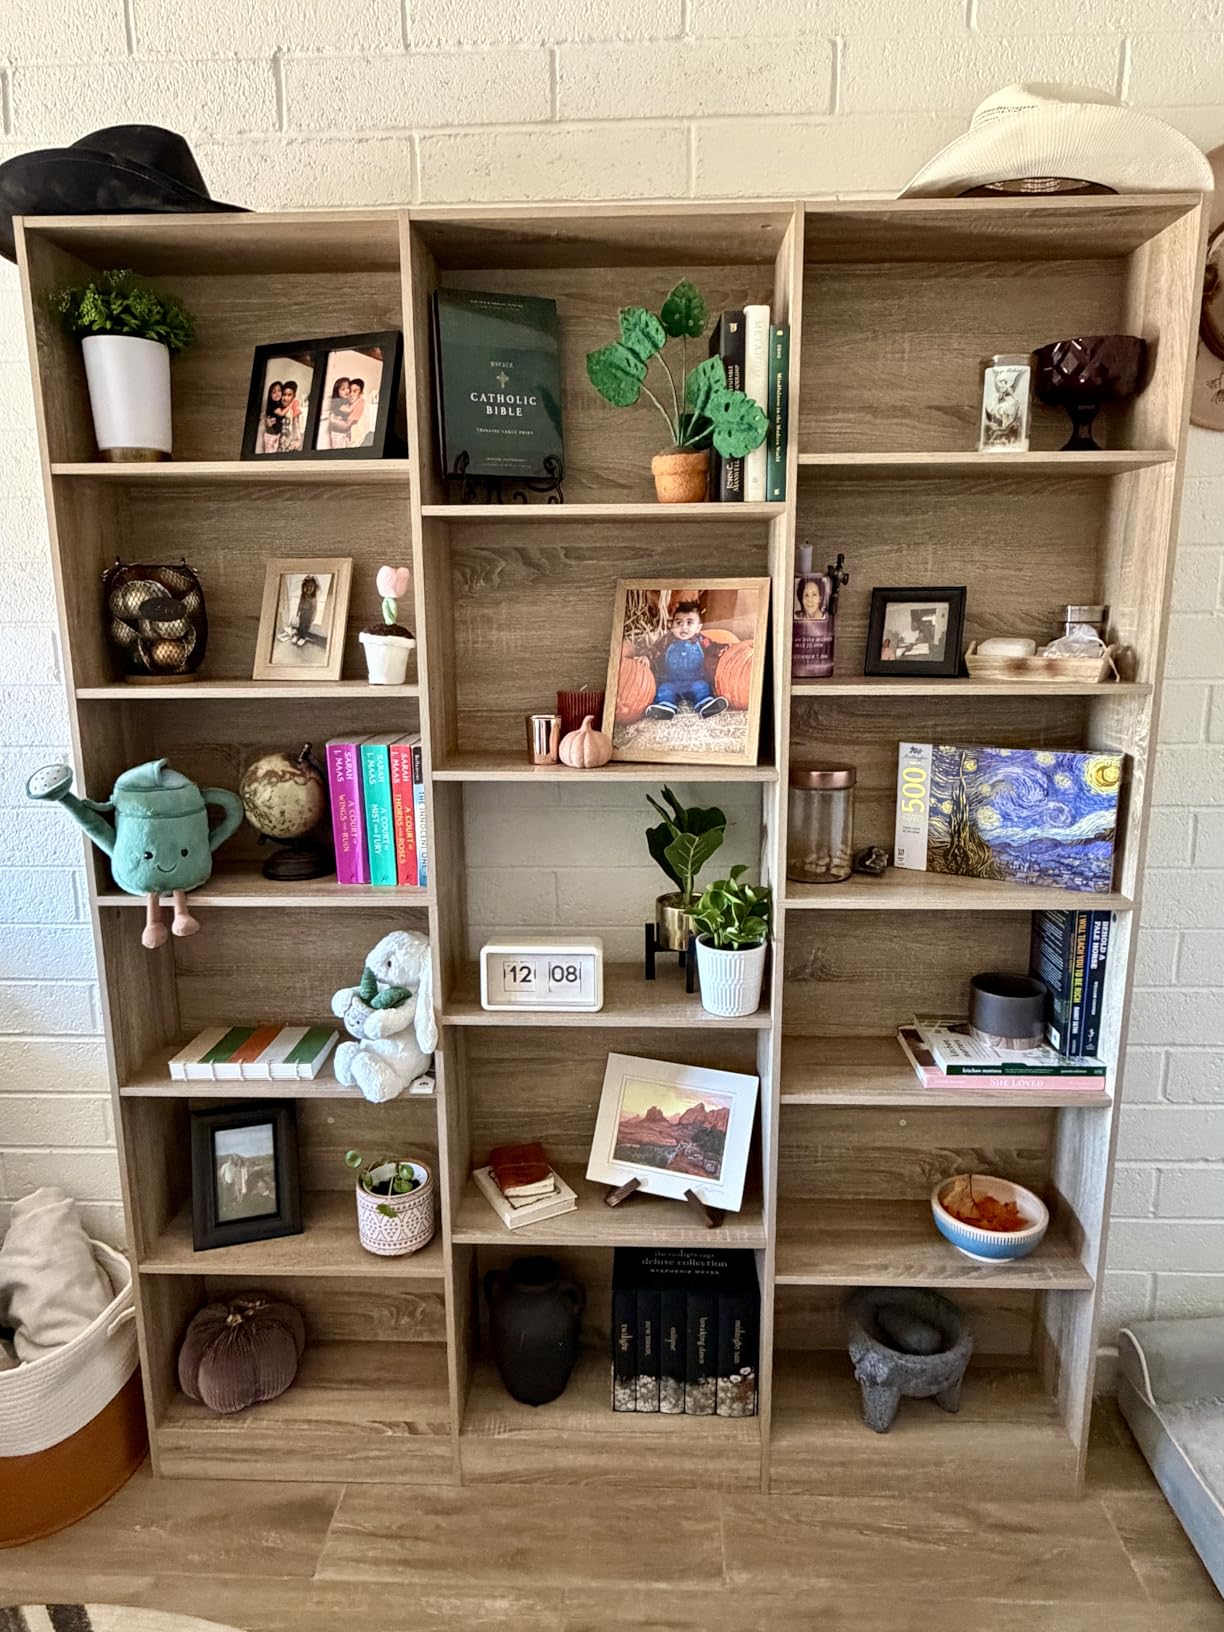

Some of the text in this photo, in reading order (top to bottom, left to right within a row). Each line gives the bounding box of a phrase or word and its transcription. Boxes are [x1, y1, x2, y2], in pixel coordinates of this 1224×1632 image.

[470, 392, 537, 405] CATHOLIC
[486, 405, 523, 416] BIBLE
[336, 758, 344, 783] MAAS
[345, 752, 353, 780] SARAH
[368, 760, 376, 785] MAAS
[377, 754, 385, 783] SARAH
[392, 759, 400, 784] MAAS
[401, 753, 409, 782] SARAH
[902, 767, 927, 813] 500
[339, 794, 348, 821] WINGS
[371, 803, 380, 823] MIST
[395, 793, 404, 827] THORNS
[349, 809, 358, 838] COURT
[381, 816, 390, 844] COURT
[405, 815, 414, 843] COURT
[419, 808, 427, 848] INNOCENT
[342, 832, 350, 852] RUIN
[373, 834, 382, 856] FURY
[398, 837, 406, 864] ROSES
[1079, 917, 1087, 934] WILL
[1100, 921, 1109, 953] BEHOLD
[1077, 935, 1085, 954] TEACH
[1090, 921, 1101, 969] PALE HORSE
[509, 965, 578, 983] 12 08
[1075, 969, 1083, 977] TO
[1076, 955, 1084, 968] YOU
[1074, 978, 1083, 986] BE
[1073, 987, 1082, 1003] RICH
[991, 1079, 1044, 1087] SHE LOVED
[641, 1257, 728, 1267] deluxe collection
